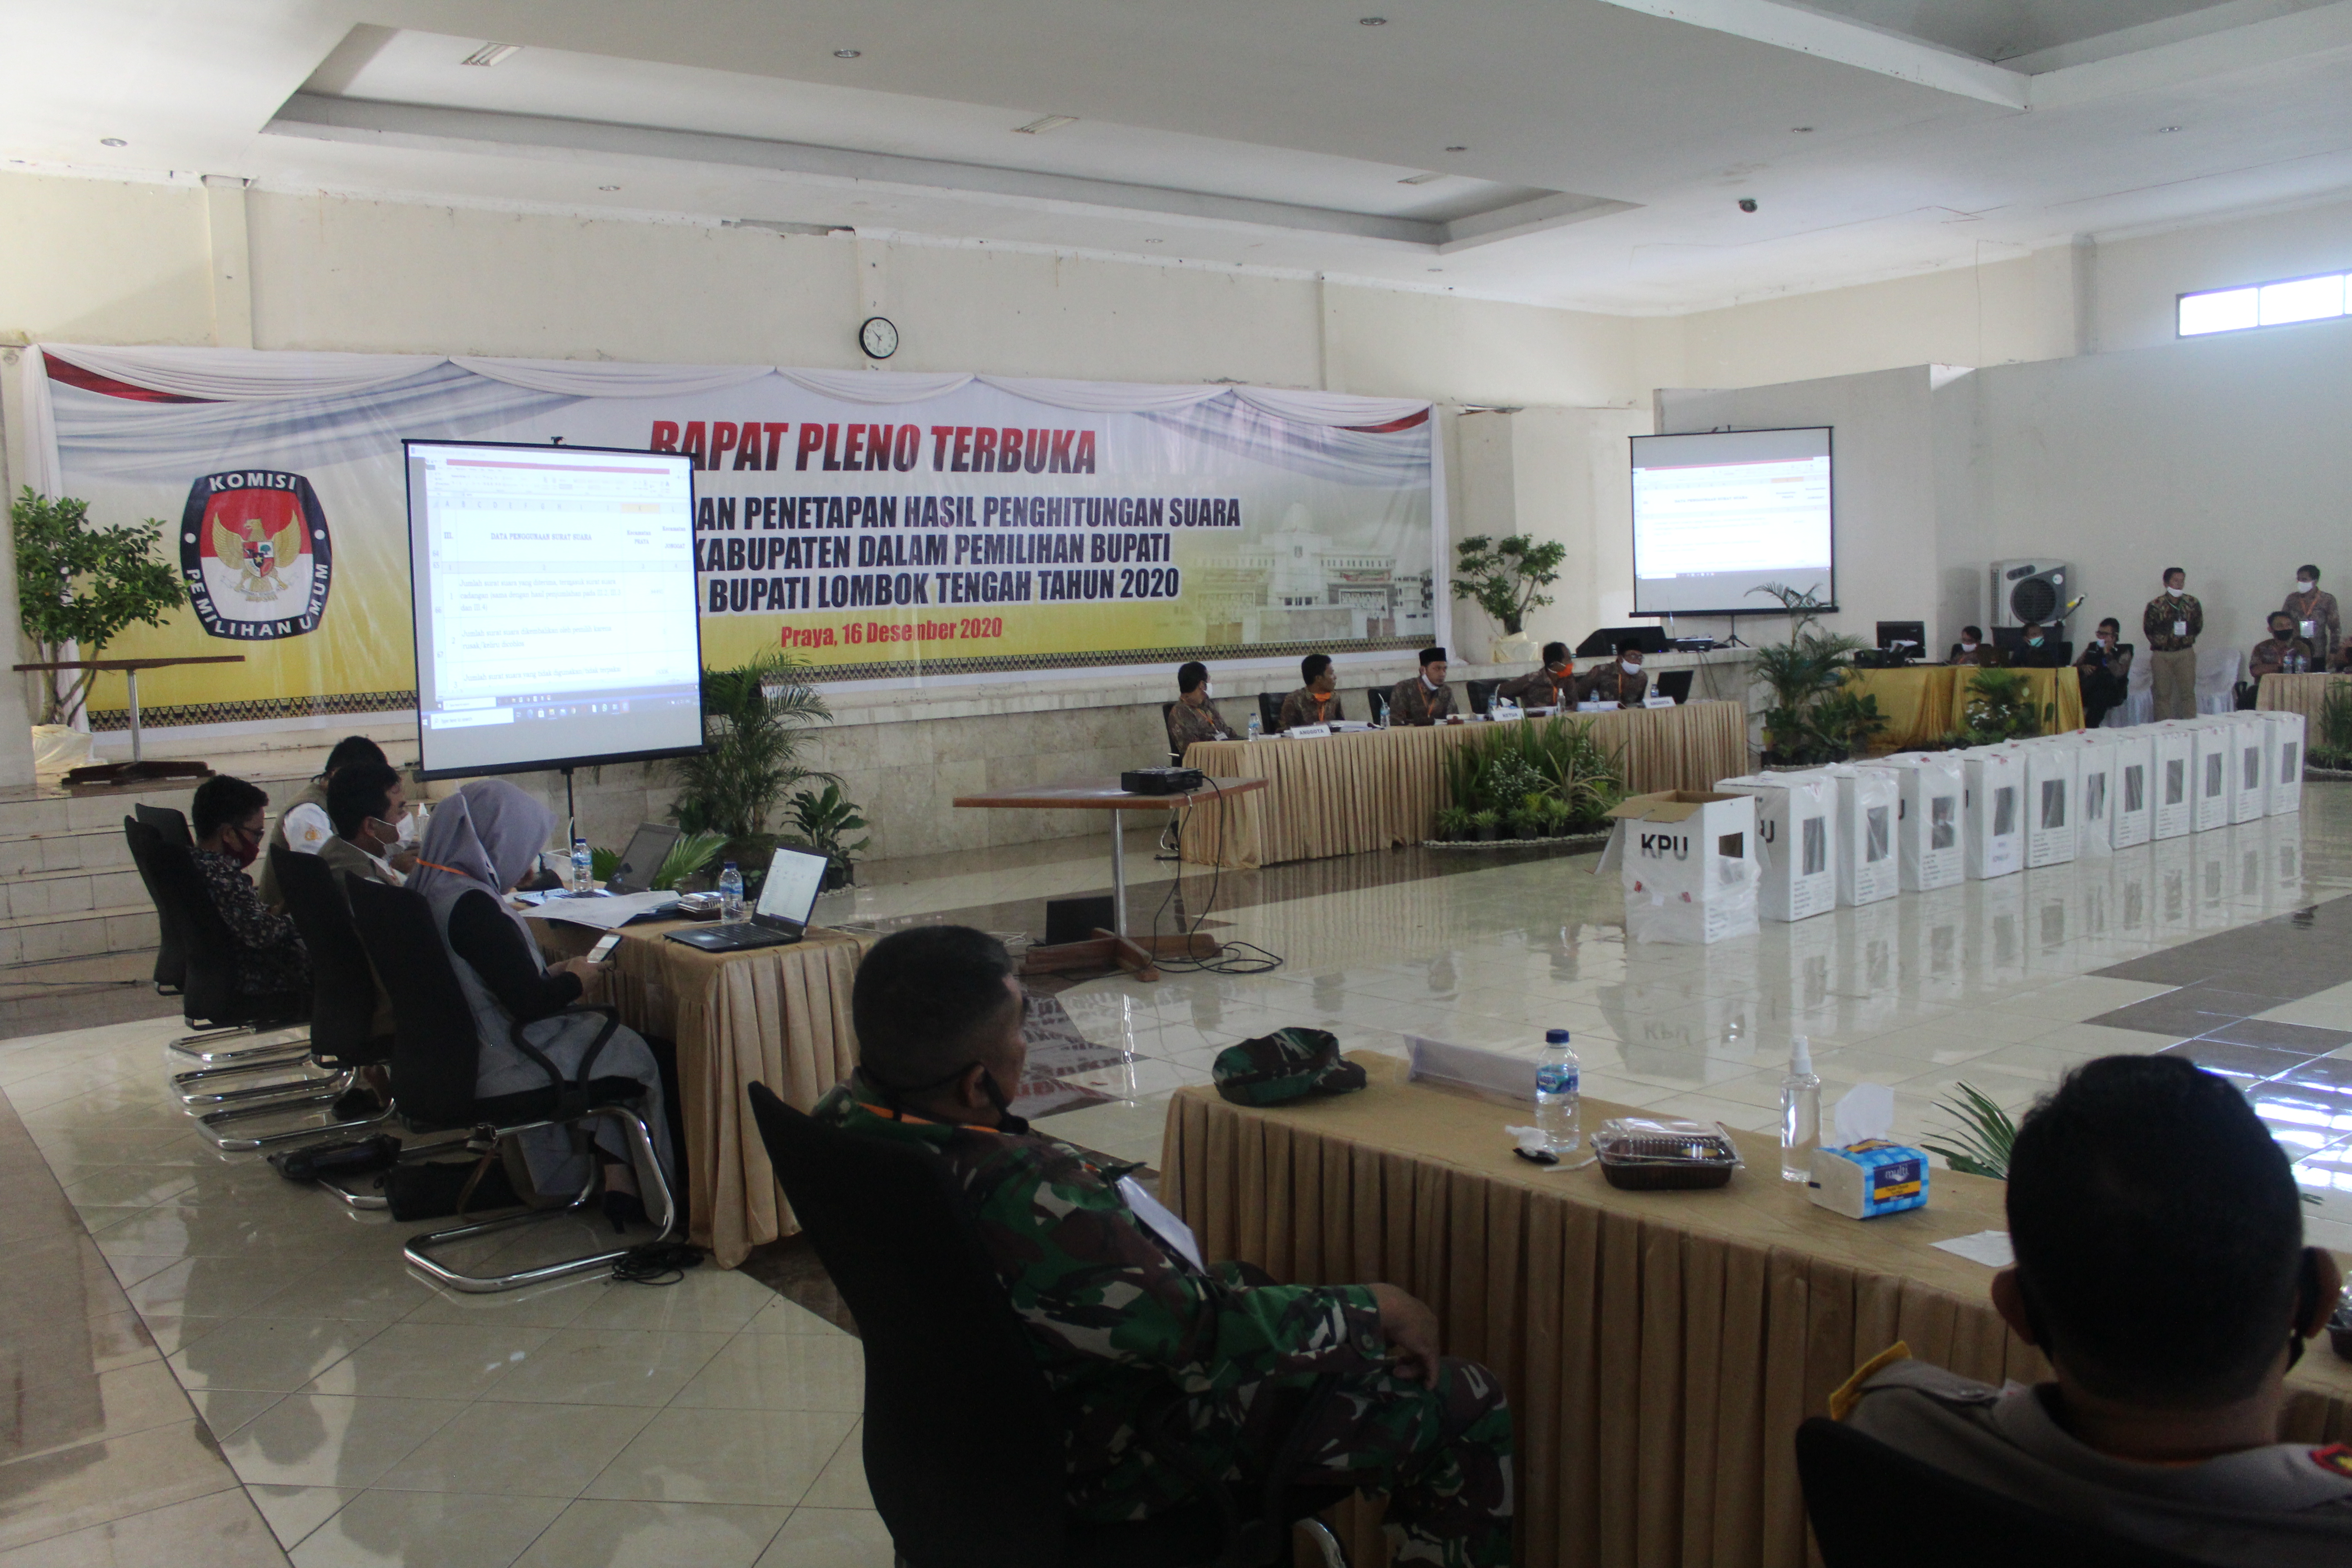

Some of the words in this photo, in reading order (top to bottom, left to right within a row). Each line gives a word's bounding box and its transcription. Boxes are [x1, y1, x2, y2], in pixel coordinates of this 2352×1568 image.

[650, 421, 789, 471] RAPAT
[795, 423, 920, 472] PLENO
[931, 426, 1095, 474] TERBUKA
[208, 473, 296, 491] KOMISI
[696, 497, 735, 530] AN
[745, 496, 897, 530] PENETAPAN
[905, 496, 976, 528] HASIL
[984, 496, 1163, 527] PENGHITUNGAN
[1169, 497, 1240, 527] SUARA
[858, 534, 947, 567] DALAM
[955, 534, 1085, 565] PEMILIHAN
[1091, 533, 1170, 563] BUPATI
[187, 569, 291, 637] PEMILIHAN
[299, 564, 328, 629] UMUM
[461, 592, 489, 600] cadangan
[509, 591, 529, 599] dengan
[545, 590, 581, 599] penjumlahan
[709, 577, 809, 612] BUPATI
[818, 573, 929, 608] LOMBOK
[936, 571, 1032, 604] TENGAH
[1037, 570, 1114, 601] TAHUN
[1120, 568, 1179, 598] 2020
[781, 626, 838, 648] Praya,
[842, 623, 862, 644] 16
[867, 620, 956, 643] Desember
[960, 617, 1002, 639] 2020
[1641, 833, 1688, 861] KPU
